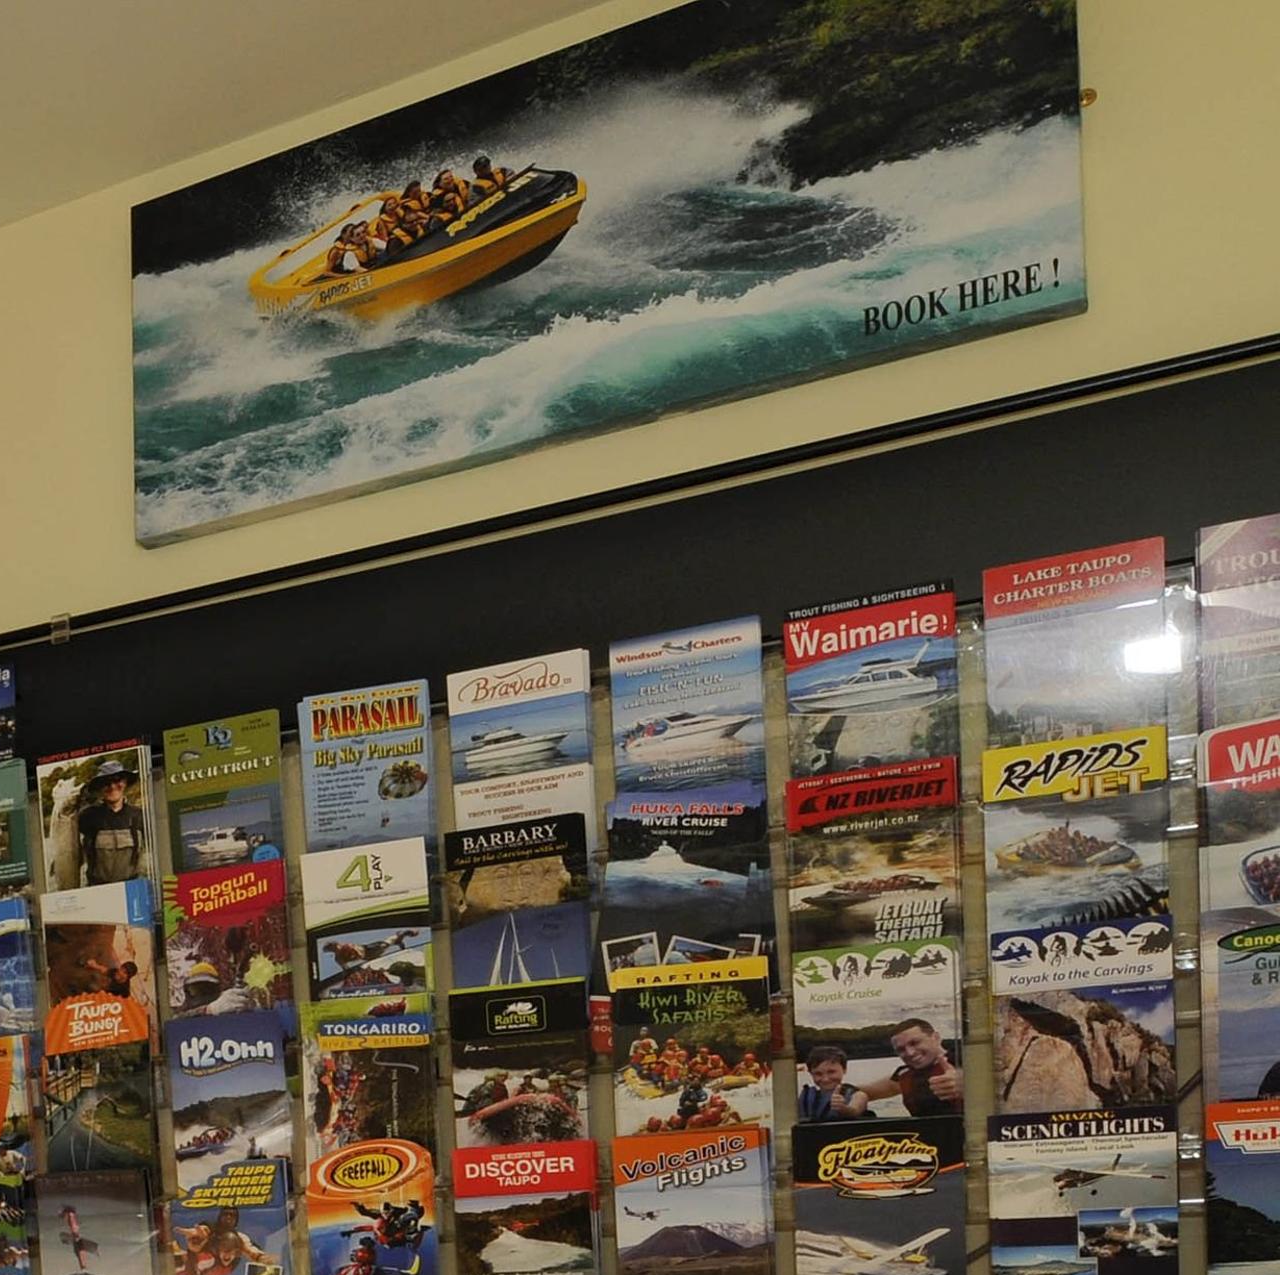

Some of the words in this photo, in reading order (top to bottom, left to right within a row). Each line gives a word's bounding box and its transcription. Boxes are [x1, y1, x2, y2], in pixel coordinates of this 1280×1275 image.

[863, 287, 949, 336] BOOK
[958, 263, 1042, 312] HERE
[1011, 564, 1063, 587] LAKE
[1066, 552, 1132, 578] TAUPO
[993, 579, 1084, 606] CHARTER
[1088, 566, 1153, 590] BOATS
[615, 649, 663, 666] Windsor
[692, 633, 743, 652] Charters
[458, 661, 562, 704] Bravado
[311, 695, 424, 743] PARASAIL
[995, 738, 1148, 796] RAPIDS
[826, 791, 852, 812] NZ
[854, 778, 947, 808] RIVERJET
[1061, 766, 1151, 804] JET
[630, 803, 684, 817] HUKA
[688, 803, 745, 816] FALLS
[641, 817, 685, 828] RIVER
[687, 816, 729, 828] CRUISE
[822, 813, 920, 835] www.riverjet.co.nz
[462, 823, 559, 852] BARBARY
[190, 870, 256, 902] Topgun
[191, 879, 269, 917] Paintball
[876, 897, 944, 922] JETBOAT
[873, 914, 945, 936] THERMAL
[873, 925, 943, 946] SAFARI
[635, 968, 741, 986] RAFTING
[1008, 970, 1050, 987] Kayak
[1052, 968, 1065, 983] to
[1066, 966, 1090, 981] the
[1093, 961, 1155, 981] Carvings
[639, 993, 678, 1010] KIWI
[684, 984, 740, 1007] RIVER
[809, 990, 845, 1004] Kayak
[846, 987, 883, 1001] Cruise
[66, 1000, 123, 1018] TAUPO
[493, 1010, 538, 1027] Rafting
[651, 1008, 726, 1026] SAFARIS
[323, 1022, 421, 1036] TONGARIRO
[1000, 1121, 1073, 1141] SCENIC
[1078, 1116, 1166, 1136] FLIGHTS
[464, 1156, 576, 1179] DISCOVER
[618, 1134, 746, 1181] Volcanic
[212, 1173, 274, 1187] TANDEM
[227, 1164, 276, 1177] TAUPO
[496, 1173, 541, 1187] TAUPO
[657, 1155, 747, 1192] Flights
[193, 1184, 273, 1199] SKYDIVING
